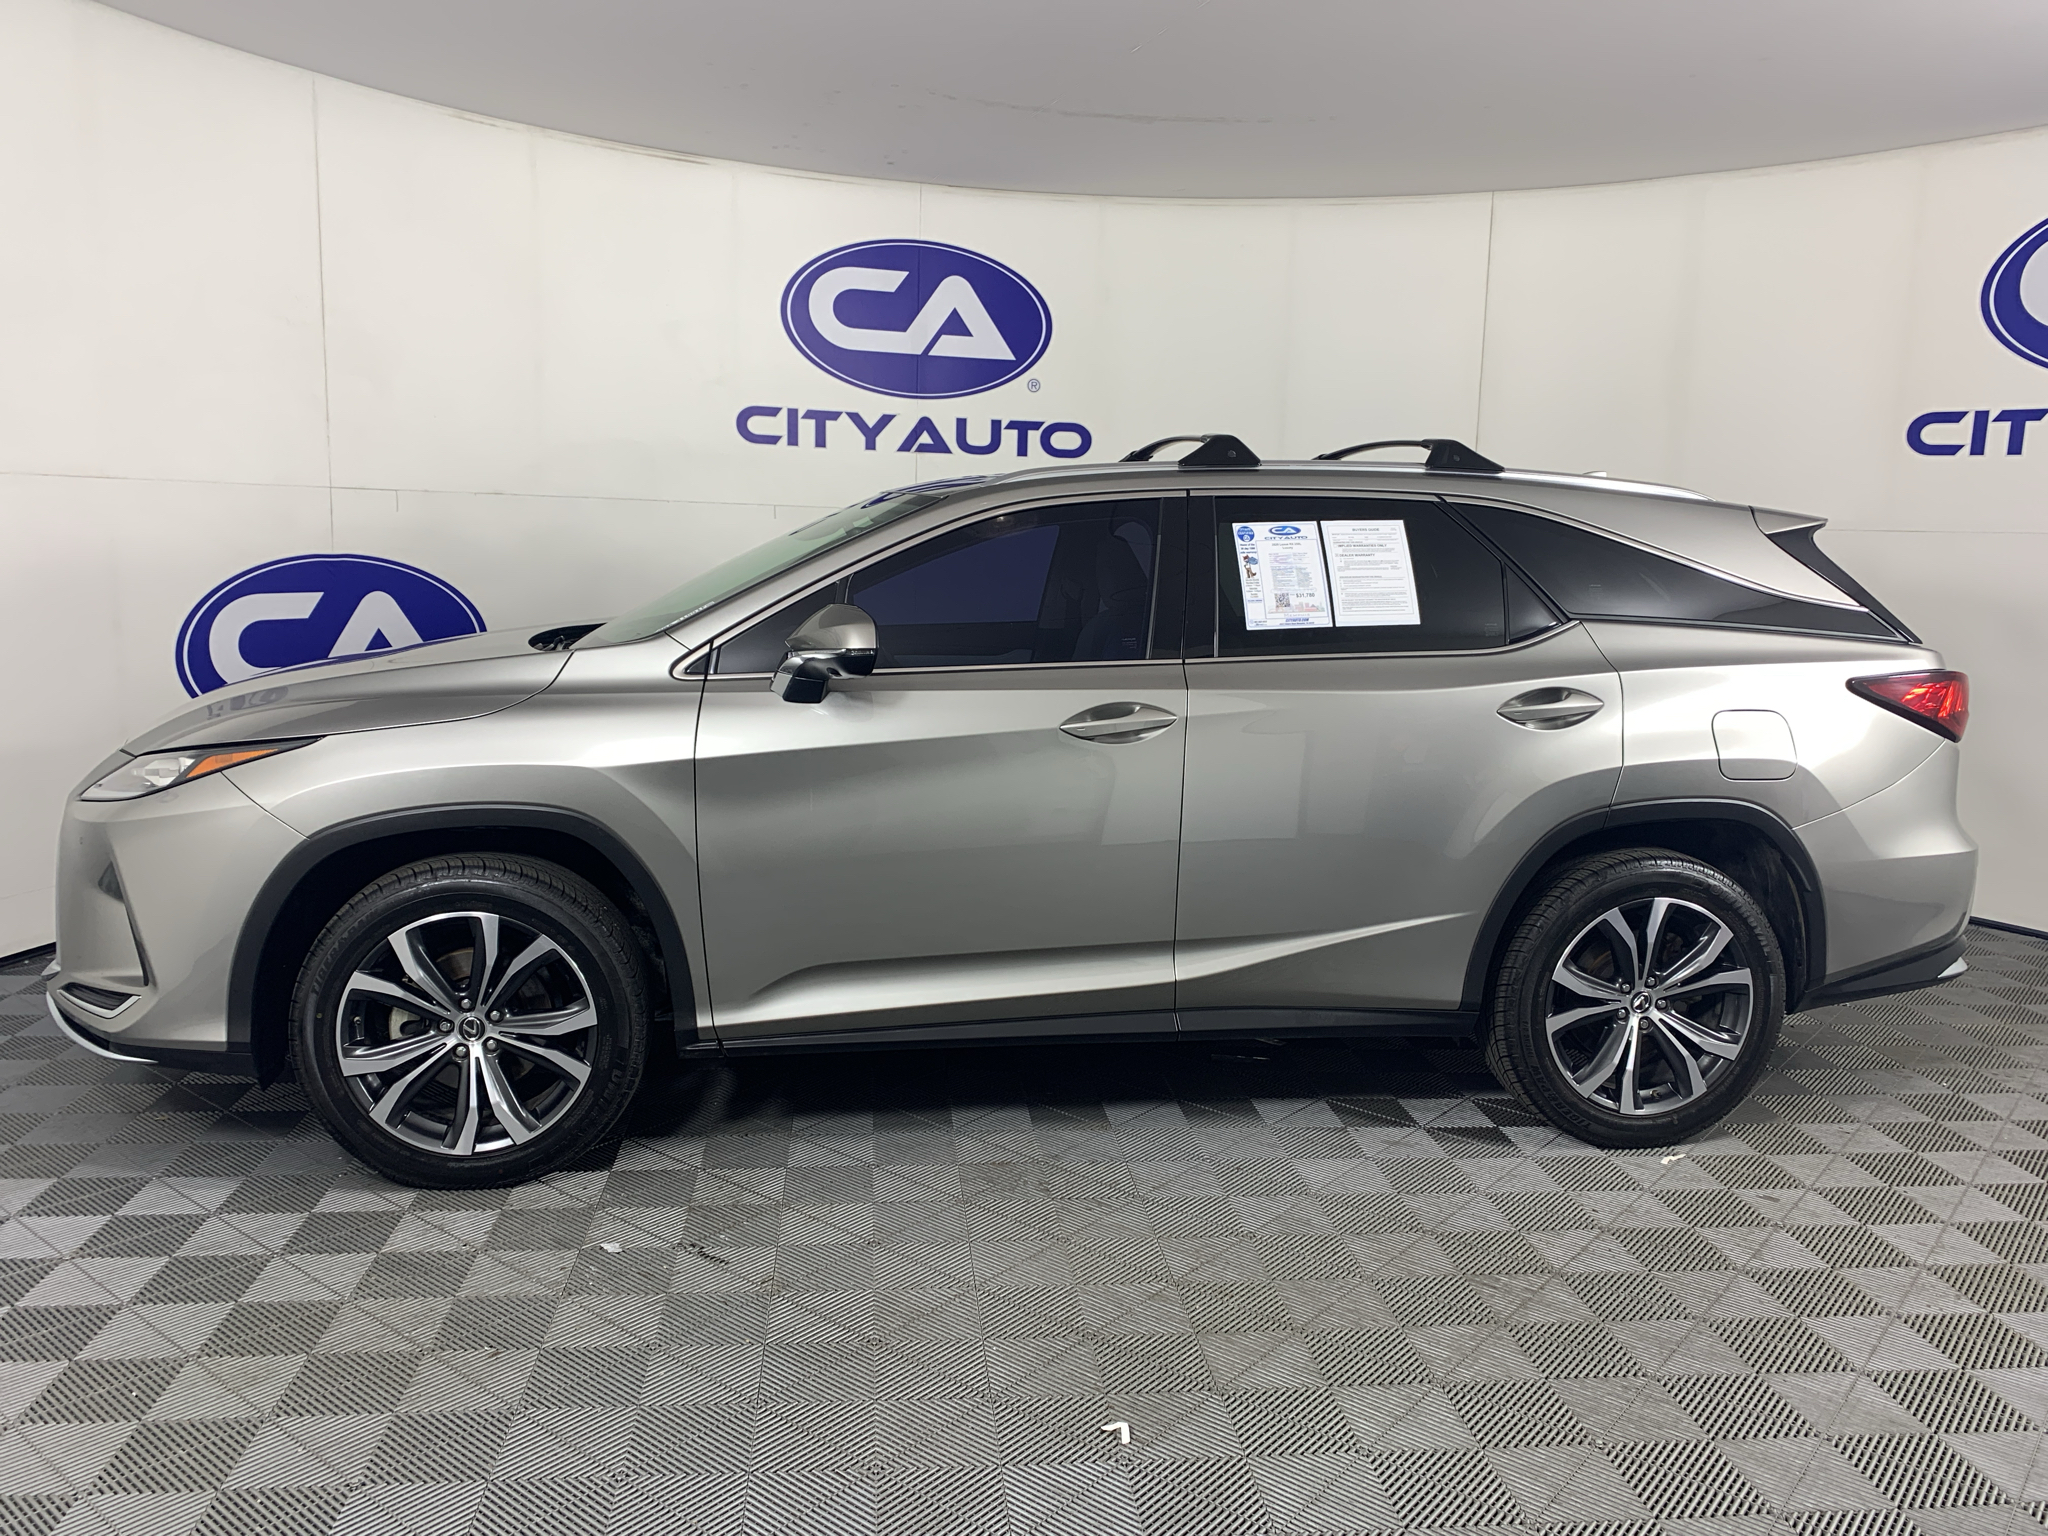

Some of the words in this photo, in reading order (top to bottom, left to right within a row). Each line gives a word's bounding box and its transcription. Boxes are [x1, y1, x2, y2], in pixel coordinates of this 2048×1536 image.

[808, 266, 1017, 361] CA
[735, 405, 897, 451] CITY
[896, 416, 1092, 459] AUTO
[1906, 408, 2048, 456] CIT
